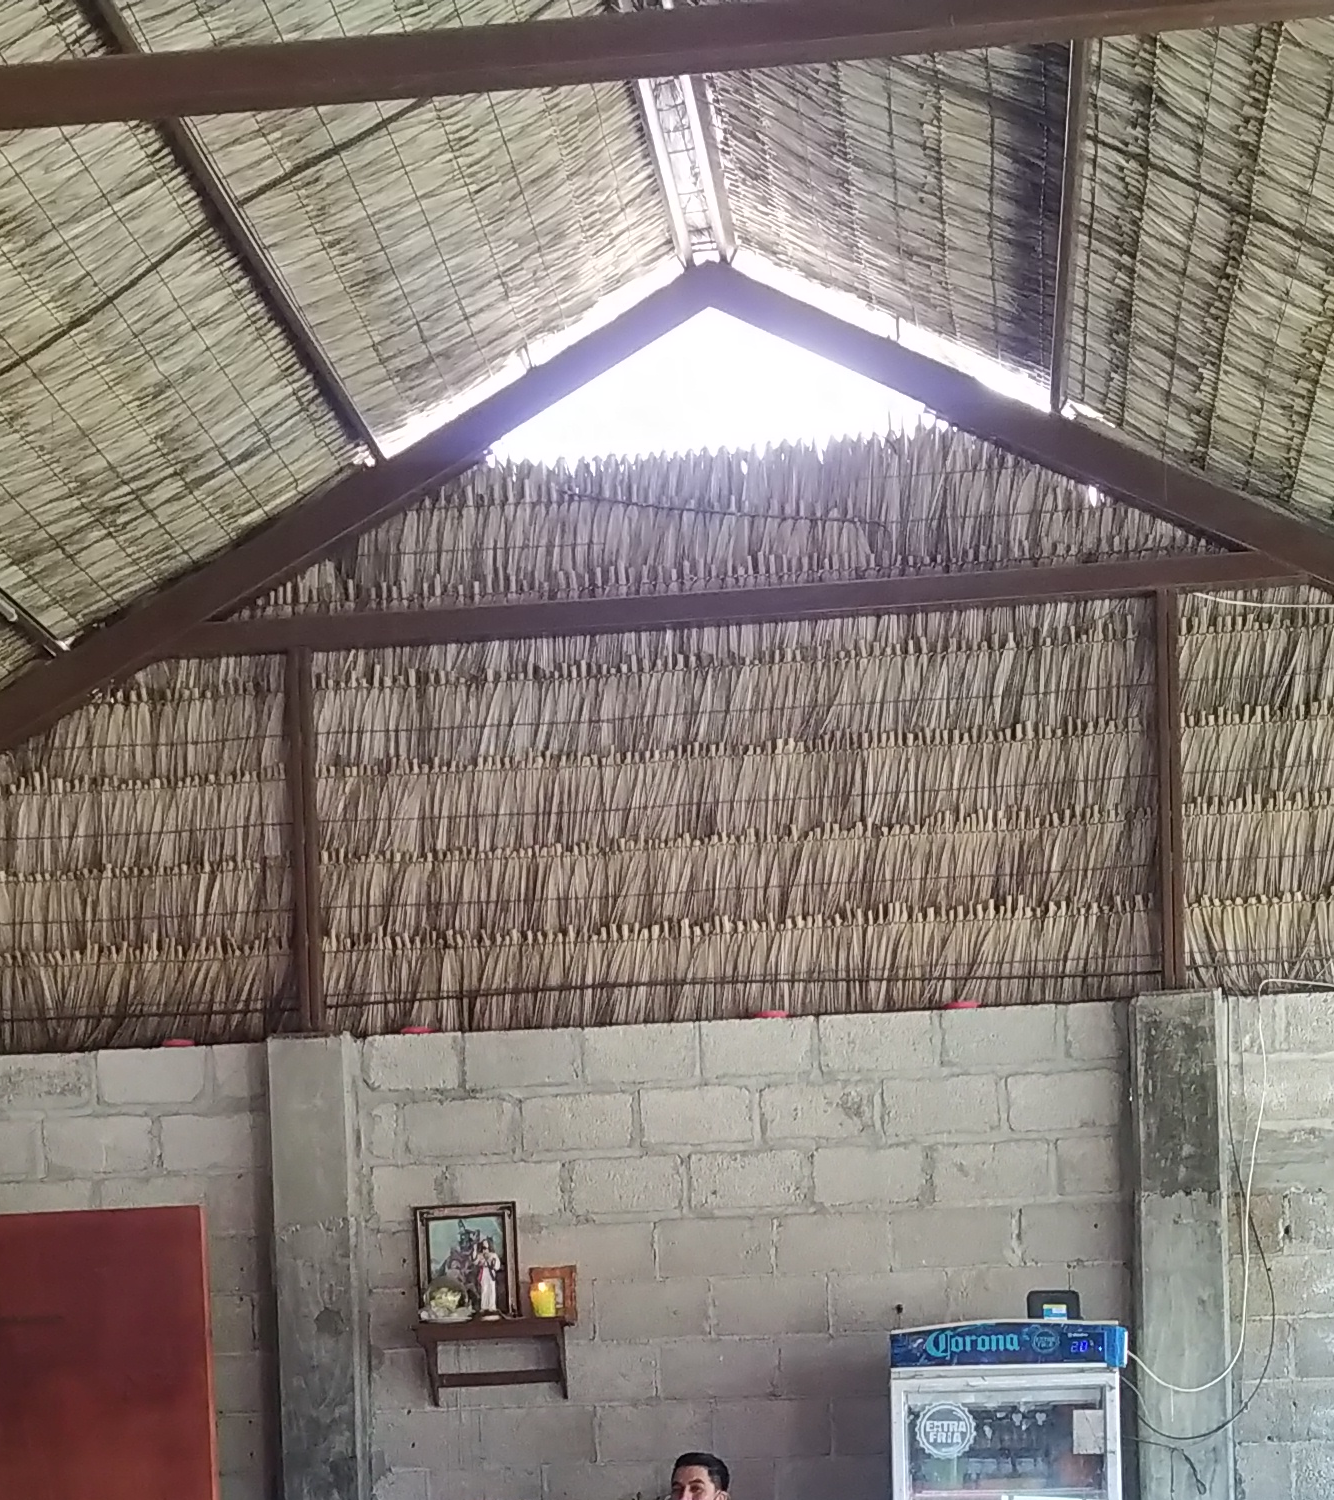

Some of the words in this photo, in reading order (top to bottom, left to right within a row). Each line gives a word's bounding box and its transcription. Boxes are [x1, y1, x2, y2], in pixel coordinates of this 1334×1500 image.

[925, 1330, 1020, 1360] Corona
[926, 1420, 967, 1432] EXTRA
[929, 1432, 962, 1443] FRIA
